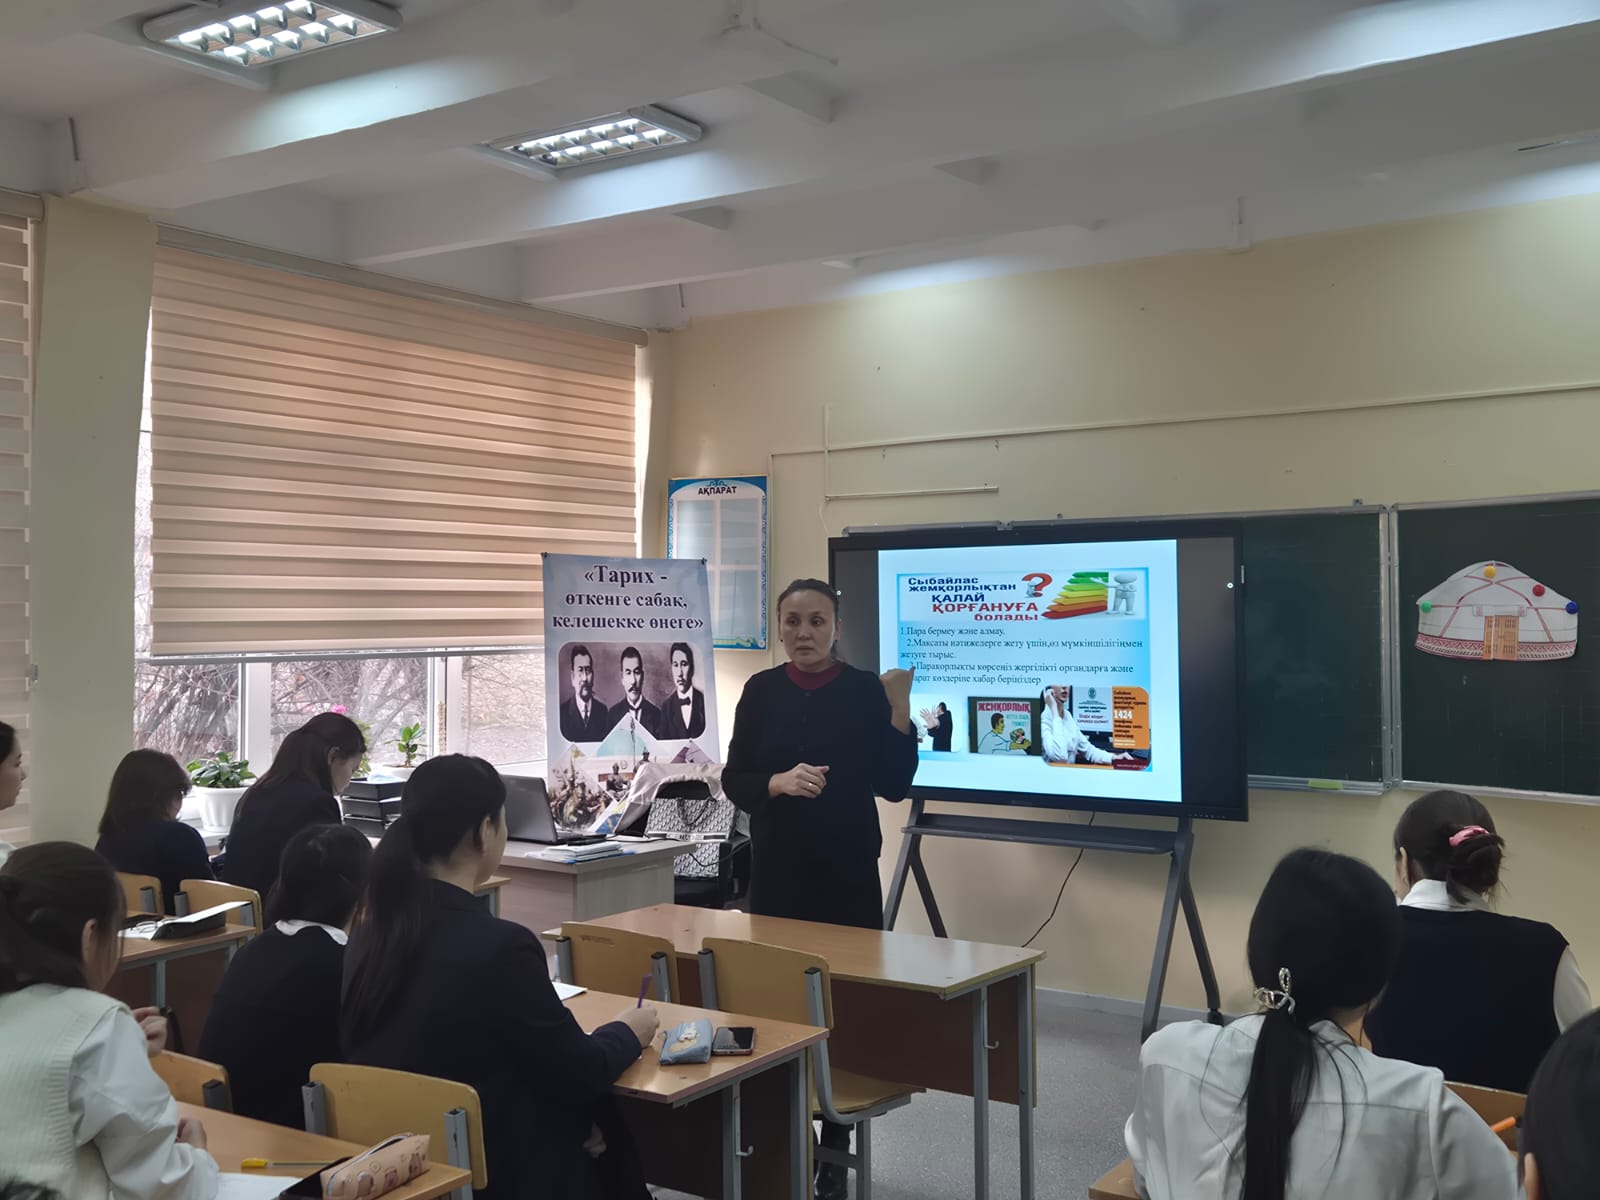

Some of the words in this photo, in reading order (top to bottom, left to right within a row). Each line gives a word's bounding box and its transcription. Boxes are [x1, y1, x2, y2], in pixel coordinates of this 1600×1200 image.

[698, 486, 737, 496] АҚПАРАТ
[584, 565, 654, 588] «Тарих
[908, 577, 979, 586] Сыбайлас
[909, 584, 1016, 593] жемқорлықтан
[566, 593, 631, 606] өткенге
[636, 592, 688, 608] сабақ,
[931, 592, 985, 603] ҚАЛАЙ
[932, 602, 1038, 614] ҚОРҒАНУҒА
[974, 613, 1038, 621] болады
[552, 616, 645, 629] келешекке
[650, 617, 704, 630] өнеге»
[900, 626, 926, 637] 1.Пара
[927, 626, 955, 637] бермеу
[979, 629, 1005, 637] алмау.
[1004, 640, 1024, 649] жету
[900, 652, 927, 660] жетуге
[972, 674, 996, 685] хабар
[1113, 709, 1133, 719] 1424
